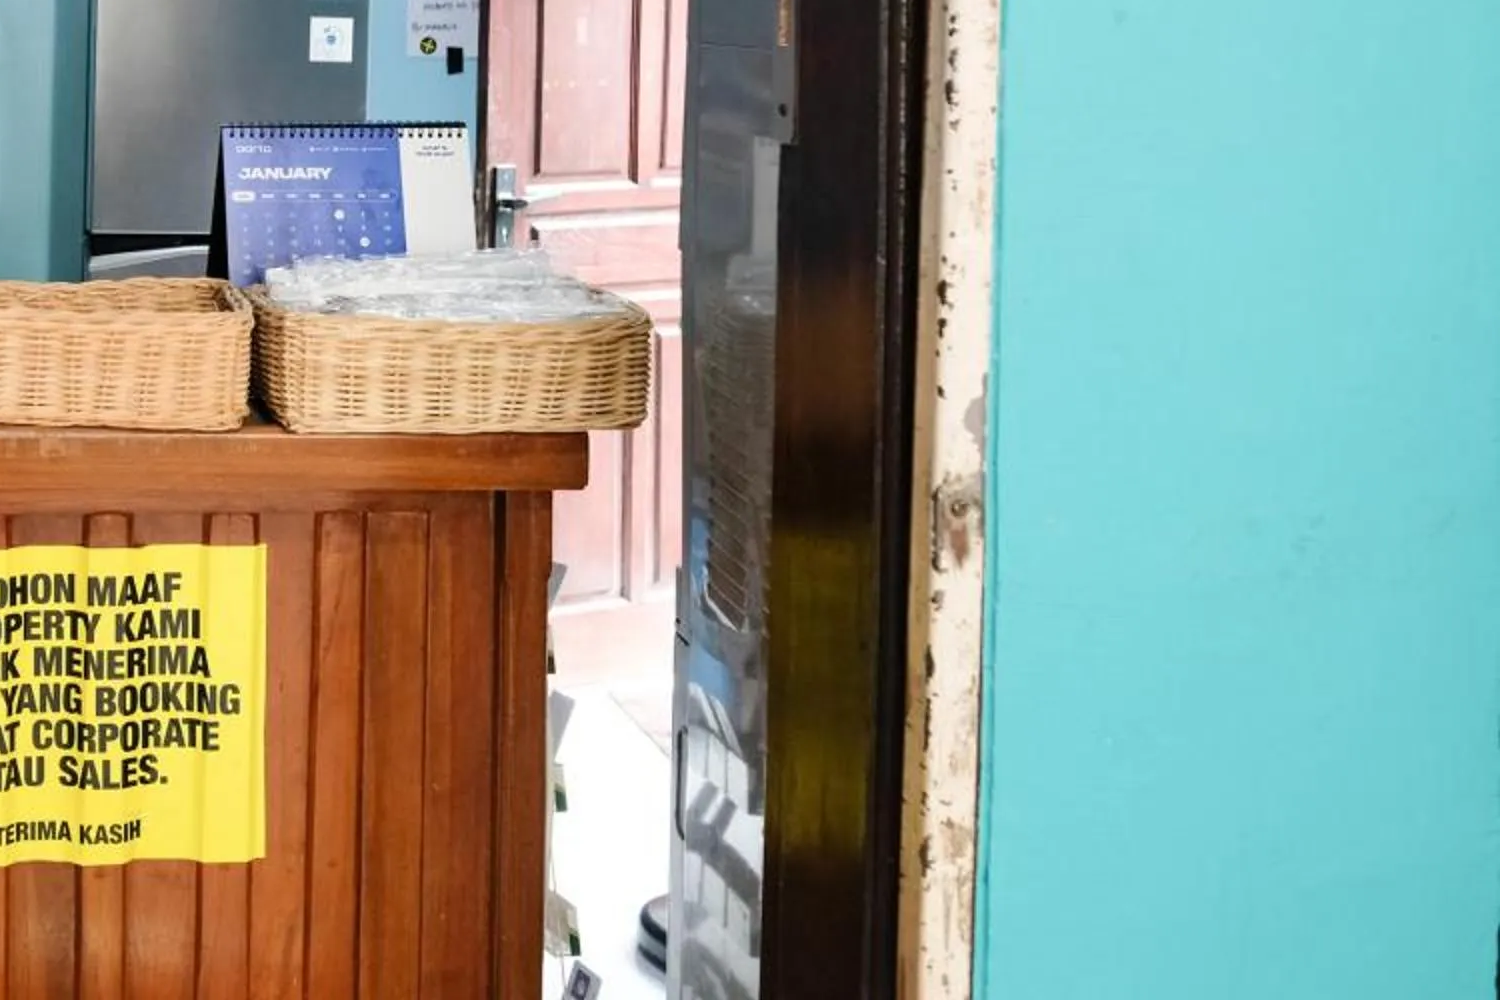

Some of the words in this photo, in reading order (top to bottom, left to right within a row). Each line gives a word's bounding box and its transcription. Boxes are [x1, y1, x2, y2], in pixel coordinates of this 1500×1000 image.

[238, 167, 332, 180] JANUARY
[87, 571, 182, 607] MAAF
[115, 608, 202, 643] KAMI
[33, 645, 212, 681] MENERIMA
[0, 684, 83, 716] YANG
[95, 682, 241, 717] BOOKING
[31, 718, 221, 754] CORPORATE
[59, 754, 169, 790] SALES.
[79, 818, 142, 845] KASIH
